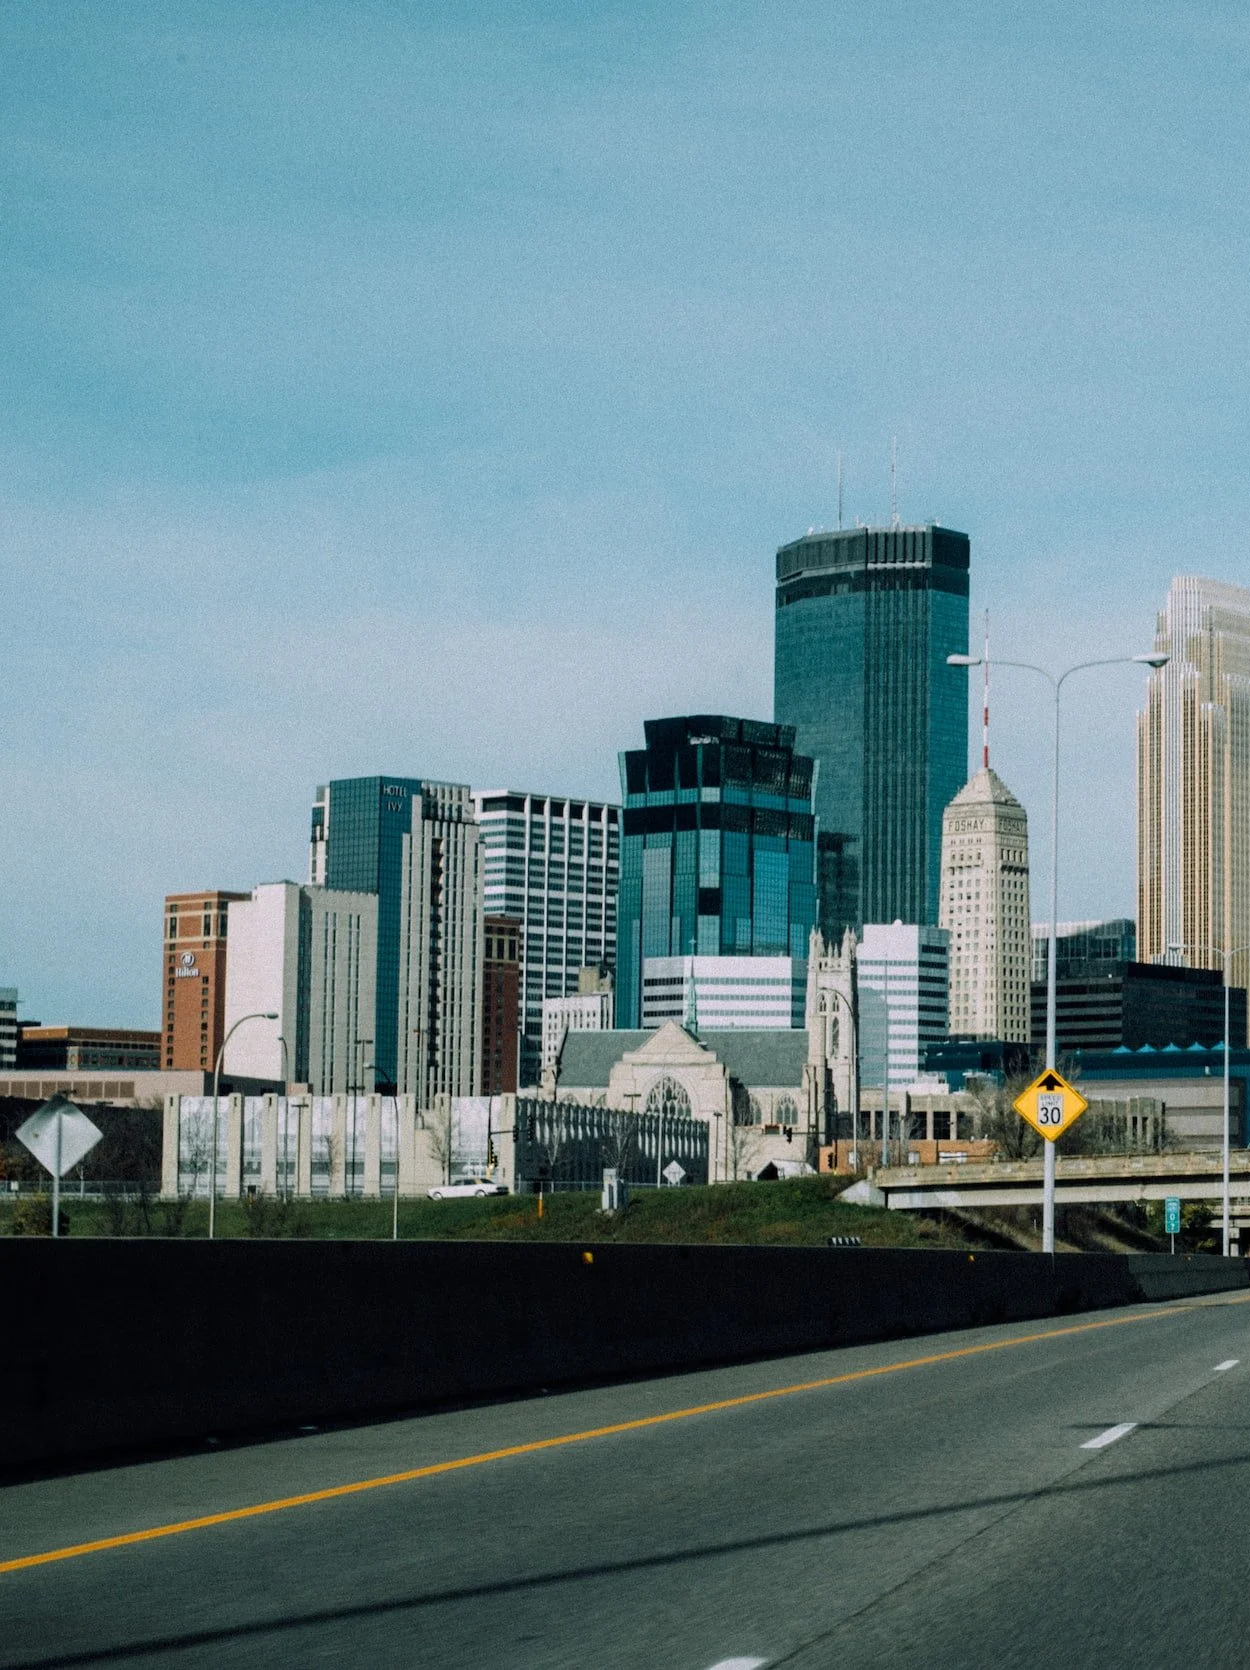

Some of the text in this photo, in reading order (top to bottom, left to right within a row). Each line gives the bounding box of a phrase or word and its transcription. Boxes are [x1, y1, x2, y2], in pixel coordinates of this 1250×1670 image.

[383, 784, 407, 797] HOTEL
[388, 801, 402, 812] IVY
[948, 818, 985, 832] FOSHAY
[999, 819, 1024, 833] FOSHAY
[175, 966, 199, 977] Hilton
[1039, 1107, 1061, 1124] 30
